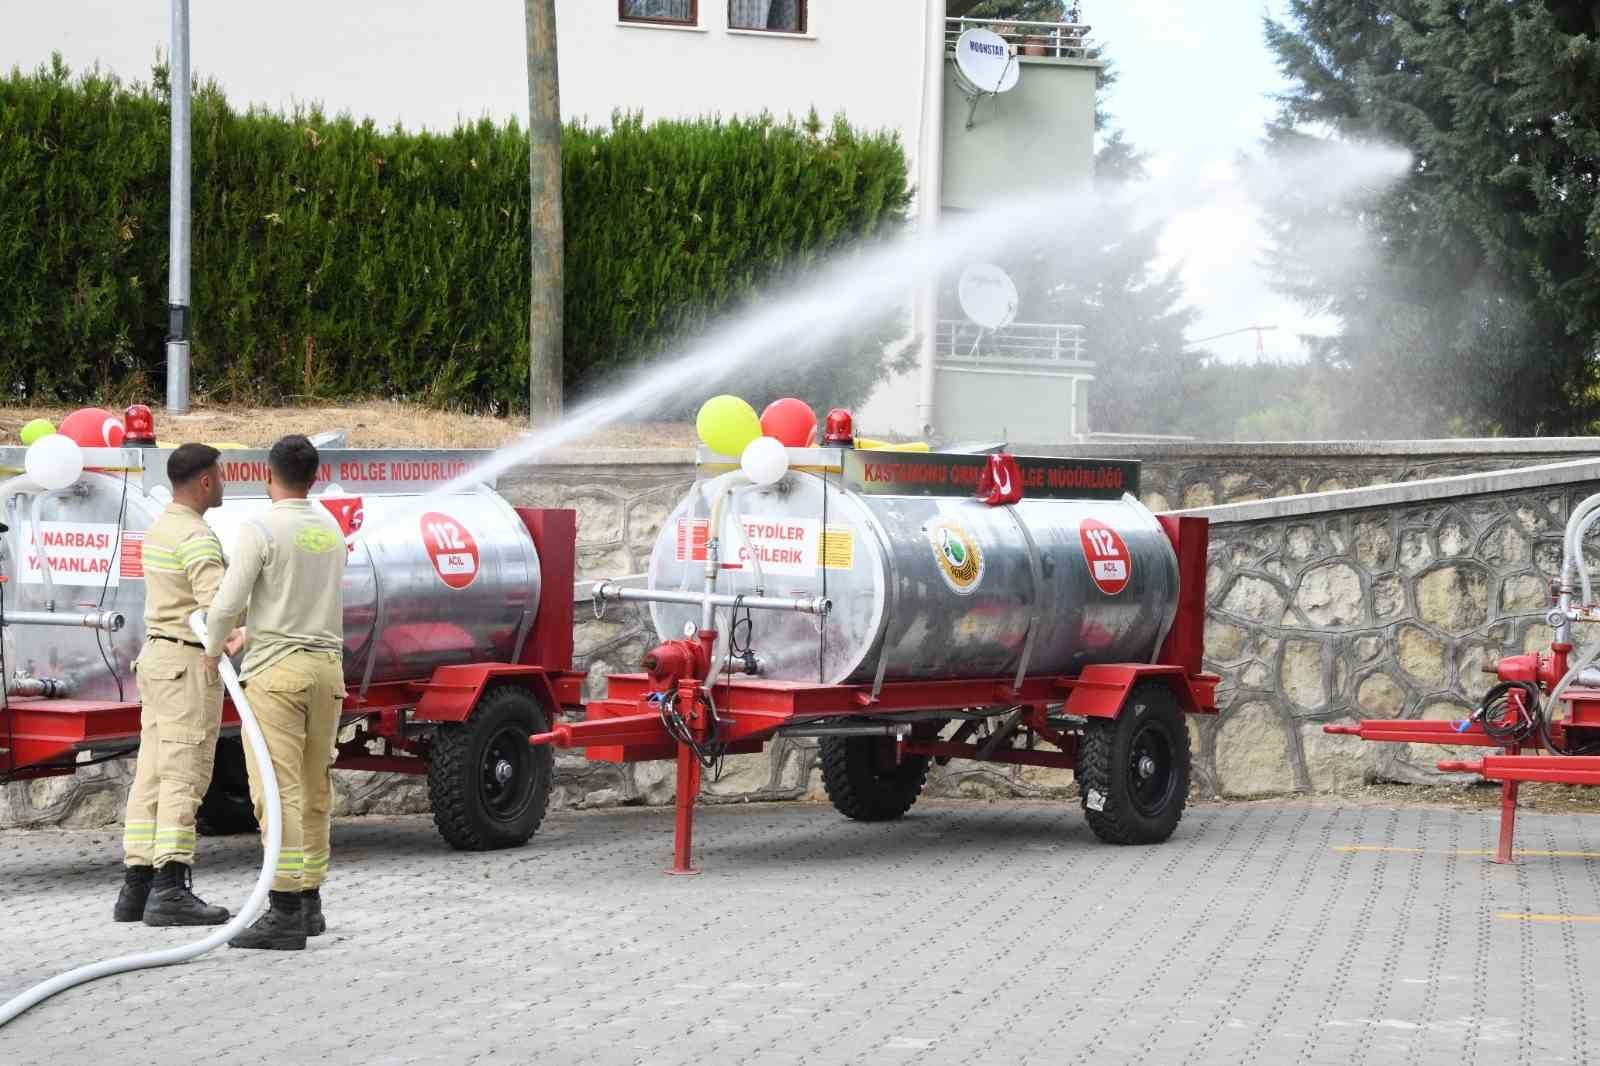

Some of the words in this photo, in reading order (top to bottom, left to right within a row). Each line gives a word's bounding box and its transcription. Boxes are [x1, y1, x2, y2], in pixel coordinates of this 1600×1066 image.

[969, 39, 1004, 57] MOONSTAR
[340, 458, 386, 481] BÖLGE
[864, 463, 948, 481] KASTAMONU
[427, 522, 466, 550] 112
[743, 522, 805, 541] EYDİLER
[1086, 529, 1119, 556] 112
